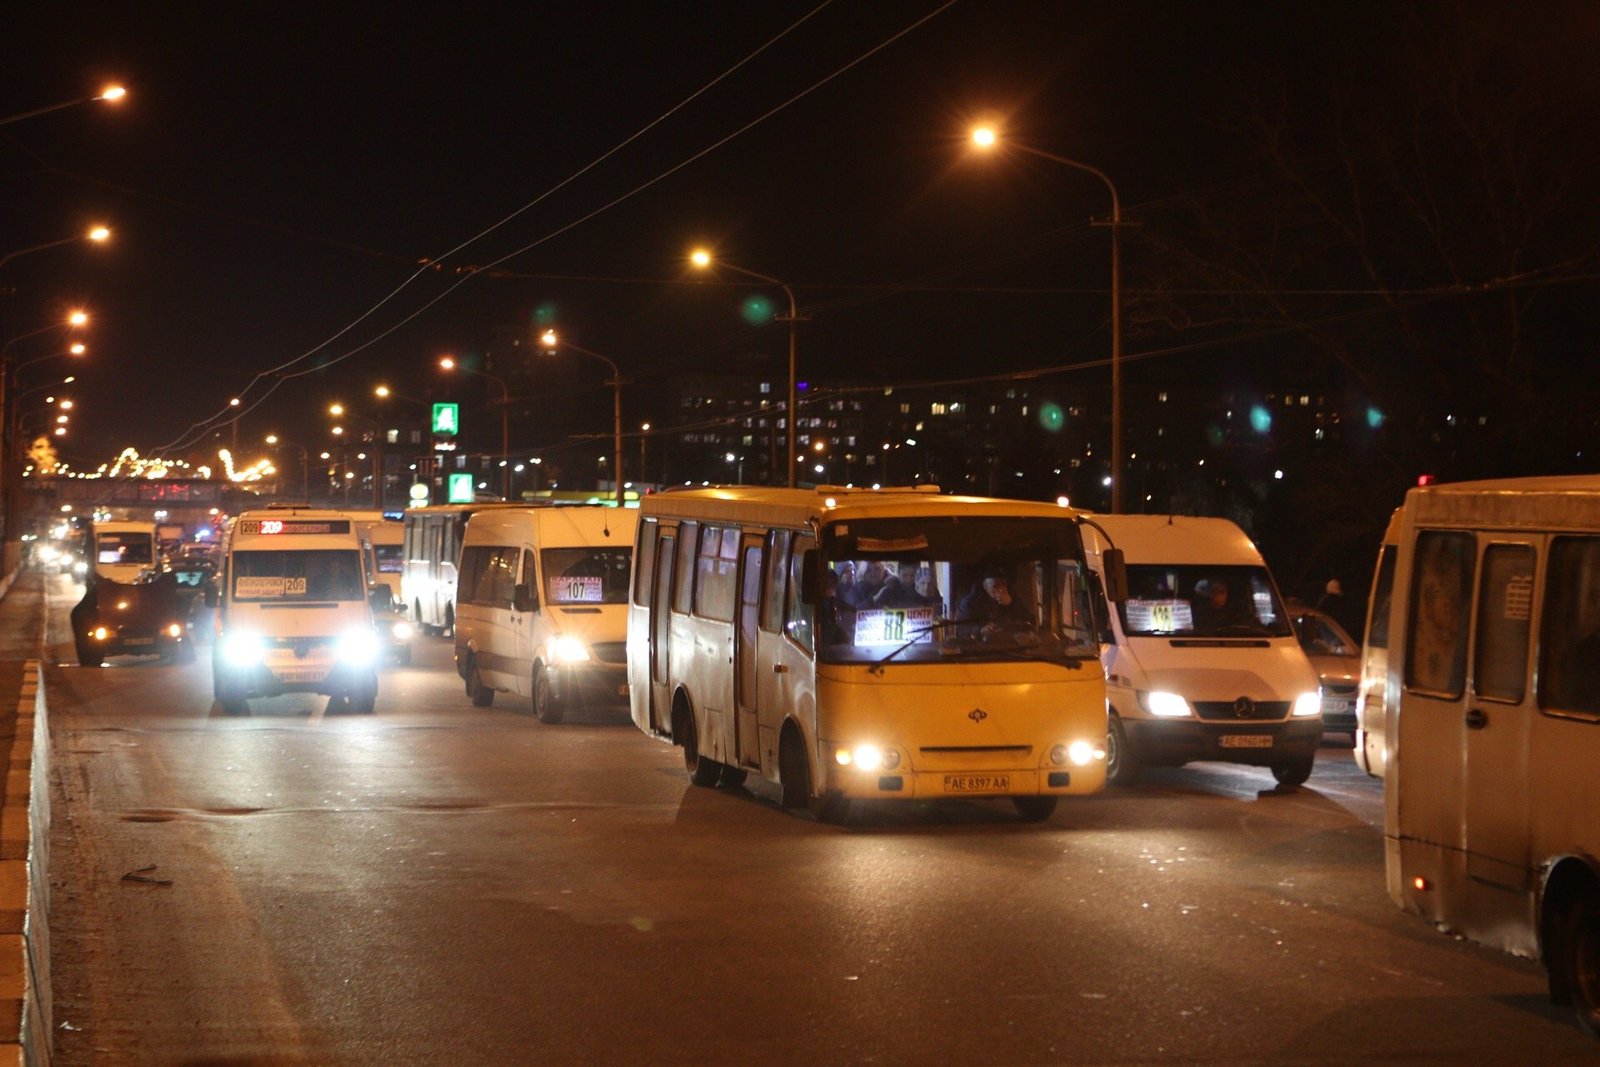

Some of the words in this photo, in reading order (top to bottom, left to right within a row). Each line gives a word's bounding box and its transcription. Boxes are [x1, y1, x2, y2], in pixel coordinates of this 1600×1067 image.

[243, 522, 258, 533] 209
[261, 521, 283, 534] 209
[287, 579, 305, 591] 209
[566, 582, 585, 599] 107
[907, 608, 932, 620] ЦЕНТР
[884, 610, 905, 641] 88
